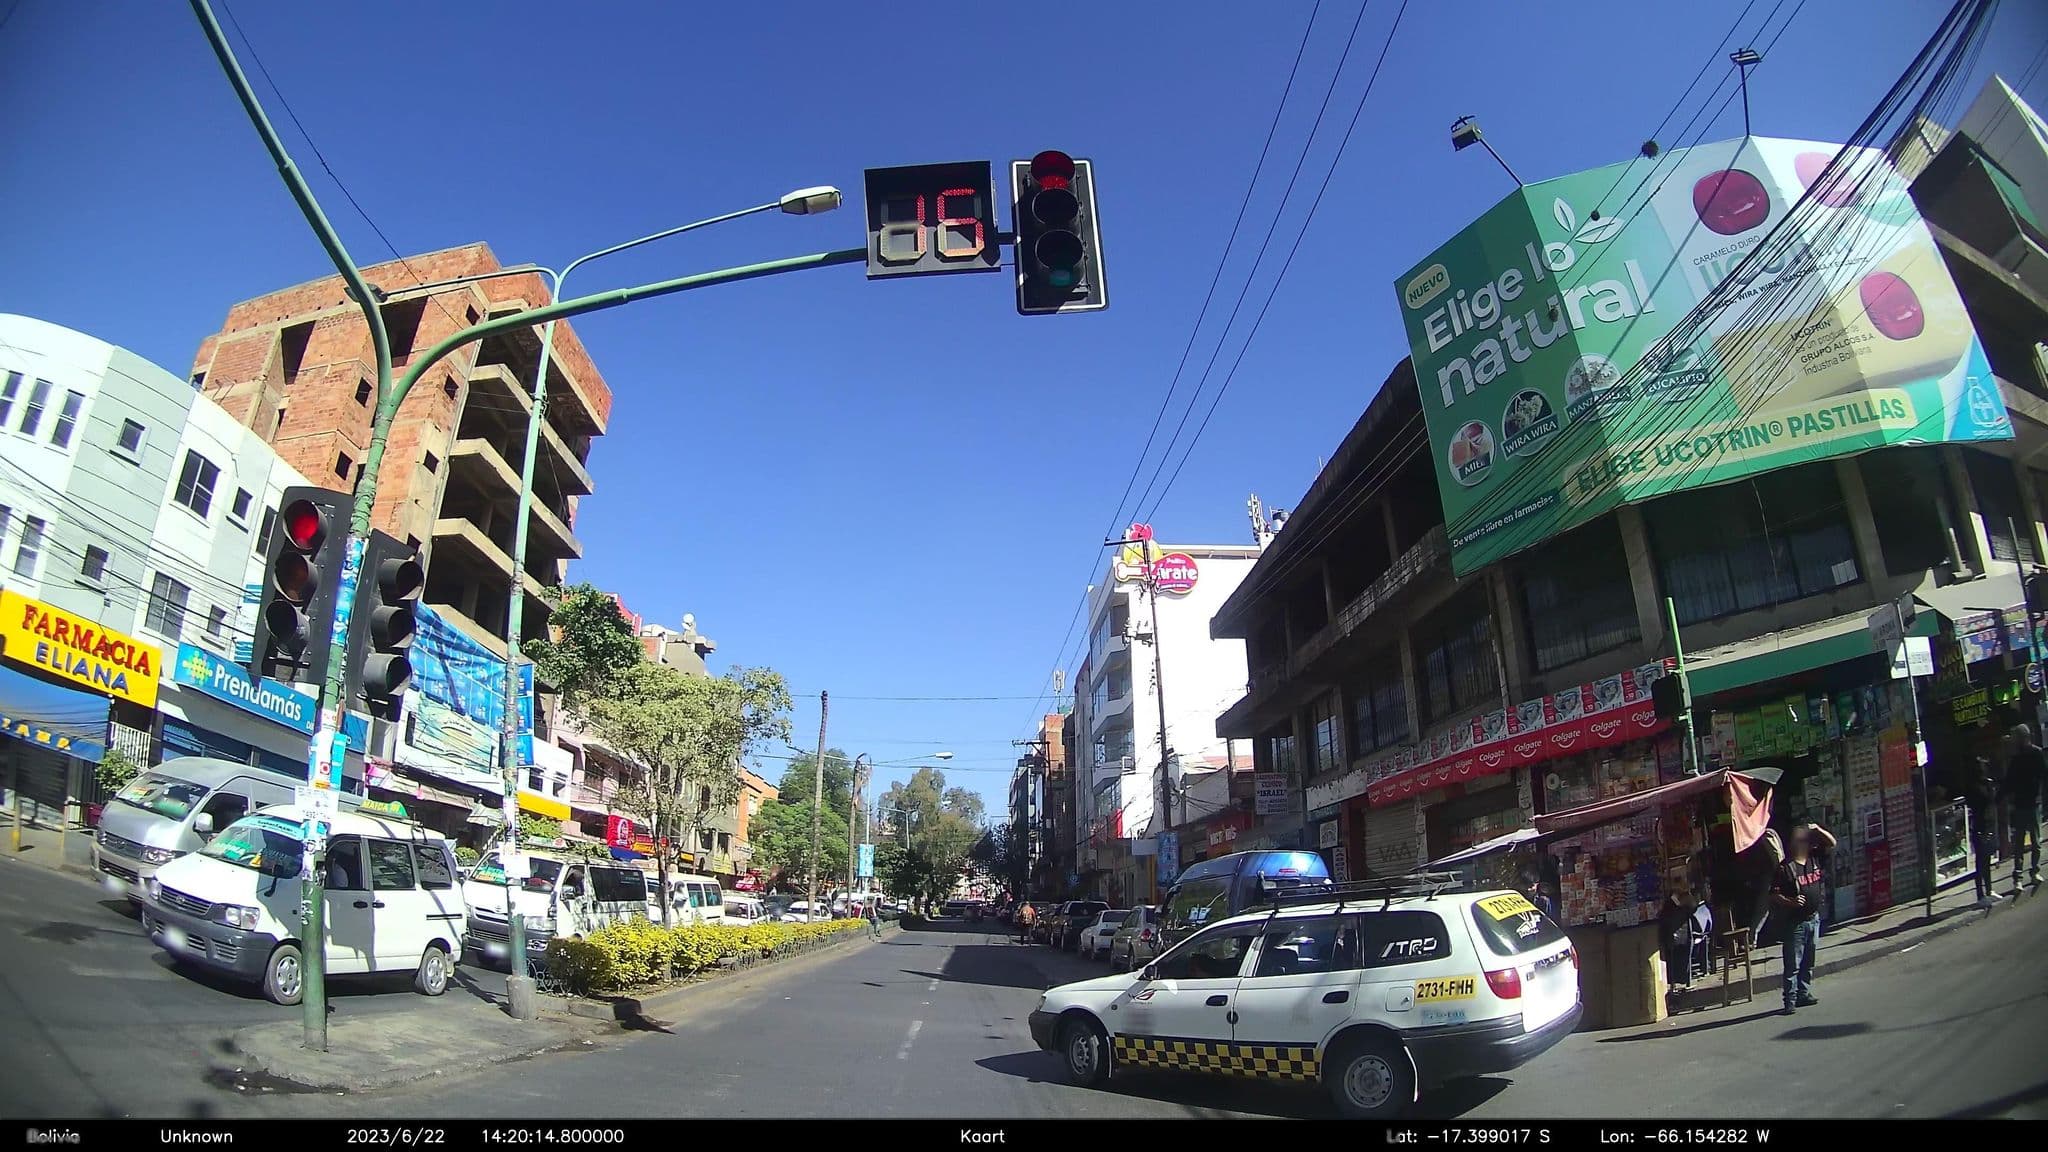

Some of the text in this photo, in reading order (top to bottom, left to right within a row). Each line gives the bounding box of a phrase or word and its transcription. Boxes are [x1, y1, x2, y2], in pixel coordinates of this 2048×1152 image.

[1693, 235, 1761, 266] CARAMELO DURO
[1409, 272, 1446, 303] NUEVO
[1423, 241, 1576, 354] Elige lo
[1437, 259, 1656, 408] natural
[1801, 346, 1832, 363] GRUPO
[1803, 358, 1839, 376] Industria
[1505, 420, 1558, 455] WIRA WIRA
[1577, 450, 1653, 494] ELIGE
[1791, 398, 1907, 439] PASTILLAS
[22, 604, 152, 676] FARMACIA
[36, 641, 130, 696] ELIANA
[214, 665, 303, 721] Prendamás
[1590, 718, 1622, 734] Colgate
[1631, 709, 1656, 723] Colga
[1513, 739, 1542, 754] Colgate
[1551, 729, 1581, 744] Colgate
[1479, 748, 1505, 764] Colgate
